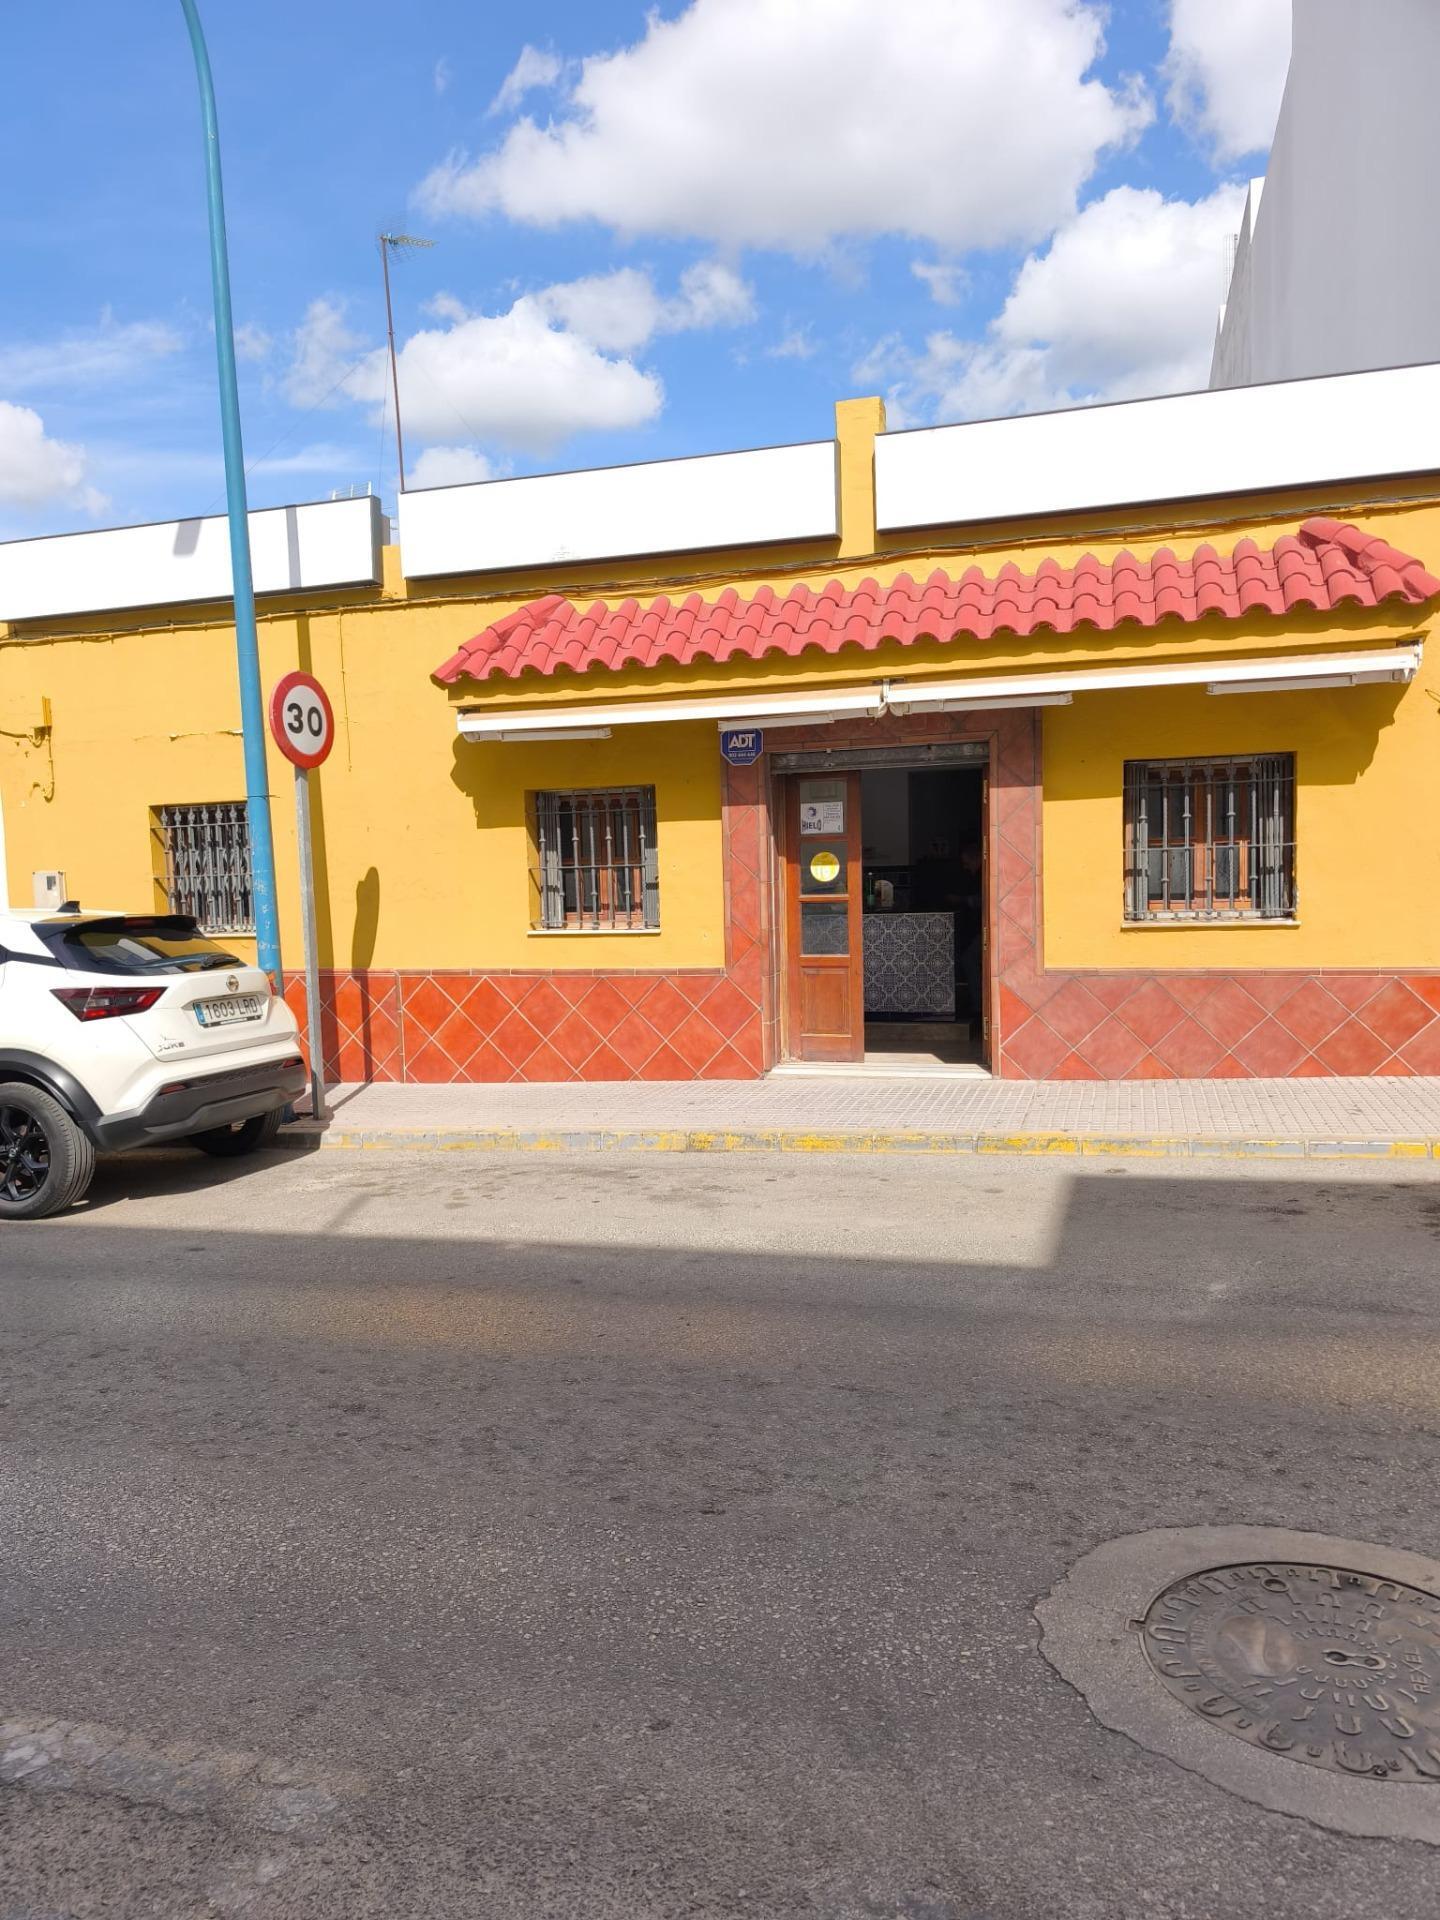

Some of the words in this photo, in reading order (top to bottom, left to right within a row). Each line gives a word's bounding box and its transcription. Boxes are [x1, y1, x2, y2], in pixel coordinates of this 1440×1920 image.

[287, 702, 323, 737] 30
[729, 733, 756, 749] ADT
[205, 1001, 235, 1020] 1603
[236, 998, 258, 1015] LRD
[1402, 1647, 1431, 1694] REXEL
